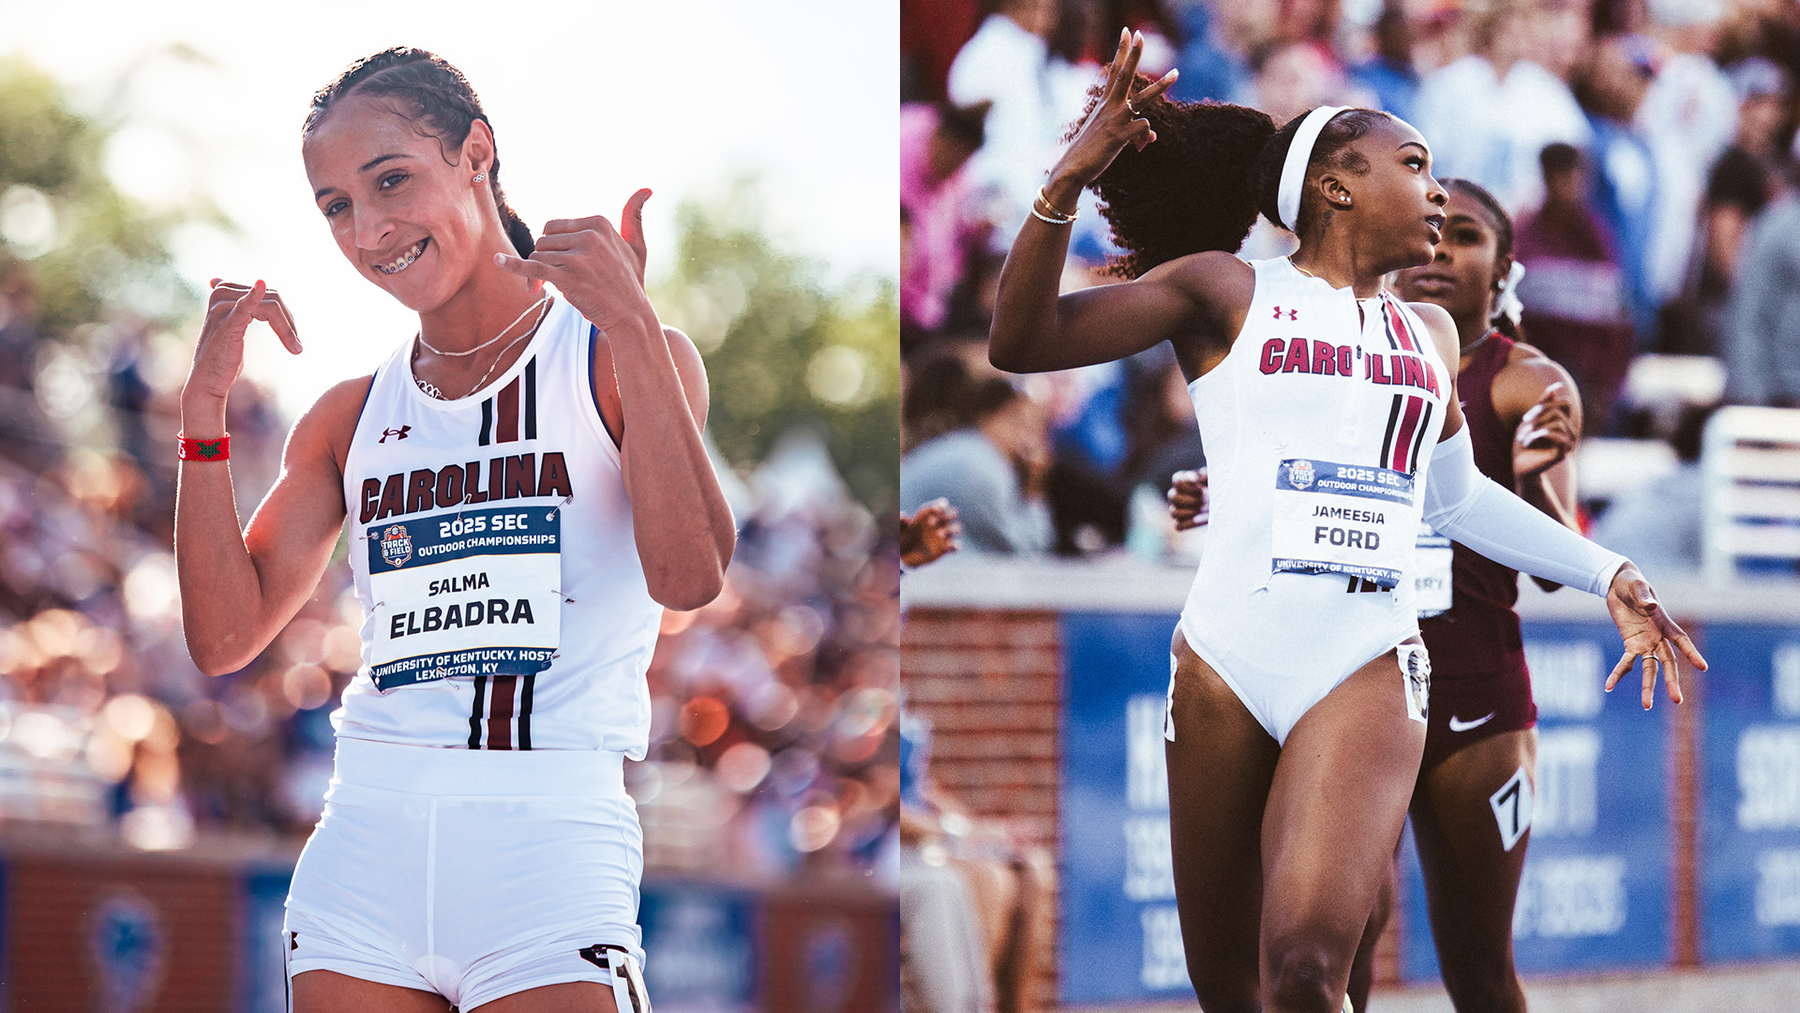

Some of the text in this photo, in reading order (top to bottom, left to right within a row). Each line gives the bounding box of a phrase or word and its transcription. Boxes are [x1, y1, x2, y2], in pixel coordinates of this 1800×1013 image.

[1259, 338, 1441, 400] CAROLINA
[359, 452, 574, 525] CAROLINA
[1317, 480, 1357, 491] OUTDOOR
[1337, 467, 1400, 486] 2025 SEC
[439, 513, 528, 539] 2025 SEC
[1312, 505, 1385, 525] JAMEESIA
[382, 538, 409, 550] TRACK
[418, 534, 556, 557] OUTDOOR CHAMPIONSHIPS
[1314, 525, 1380, 551] FORD
[390, 545, 411, 556] FIELD
[1276, 560, 1329, 571] UNIVERSITY
[1329, 563, 1342, 572] OF
[1343, 566, 1390, 579] KENTUCKY,
[1391, 572, 1401, 581] HO
[428, 572, 490, 597] SALMA
[390, 599, 535, 640] ELBADRA
[376, 650, 552, 677] UNIVERSITY OF KENTUCKY, HOST
[482, 663, 499, 674] KY
[1498, 779, 1520, 835] 7
